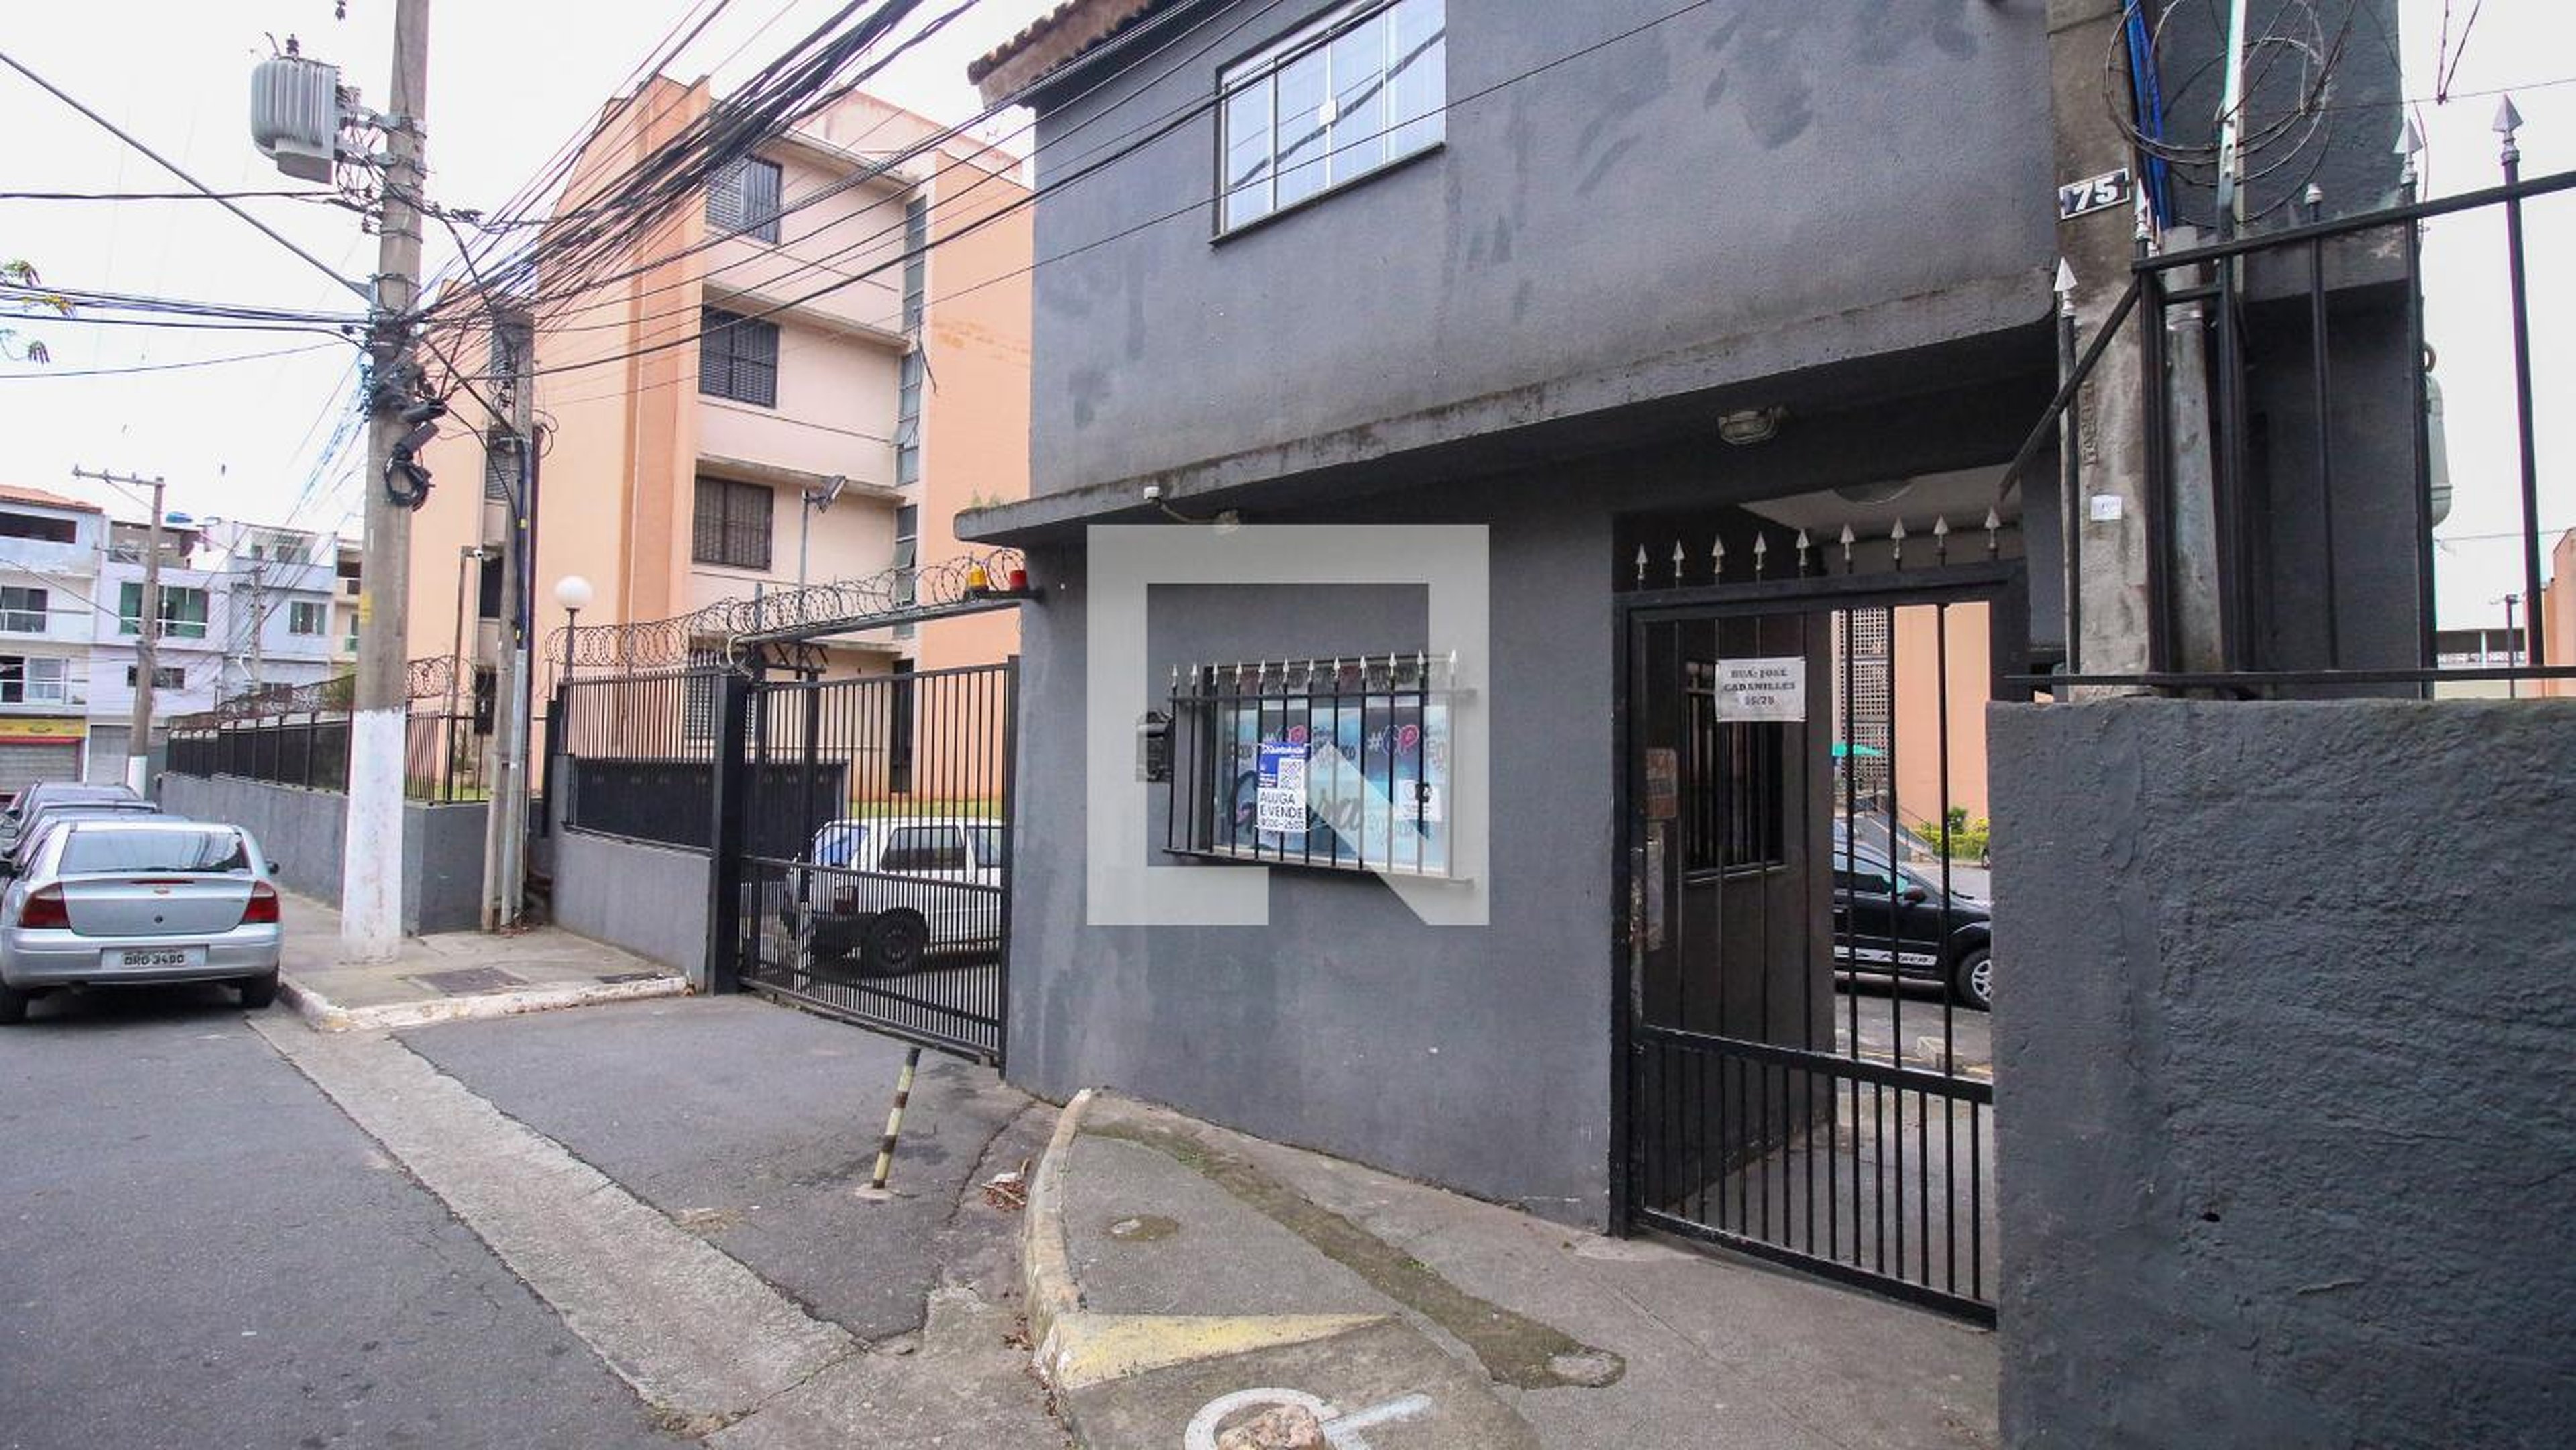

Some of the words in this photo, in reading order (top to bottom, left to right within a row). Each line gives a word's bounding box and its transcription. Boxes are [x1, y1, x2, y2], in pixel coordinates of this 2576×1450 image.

[2072, 176, 2118, 212] 75
[1260, 791, 1295, 805] ALUGA
[1260, 804, 1266, 816] E
[1268, 805, 1303, 818] VENDE
